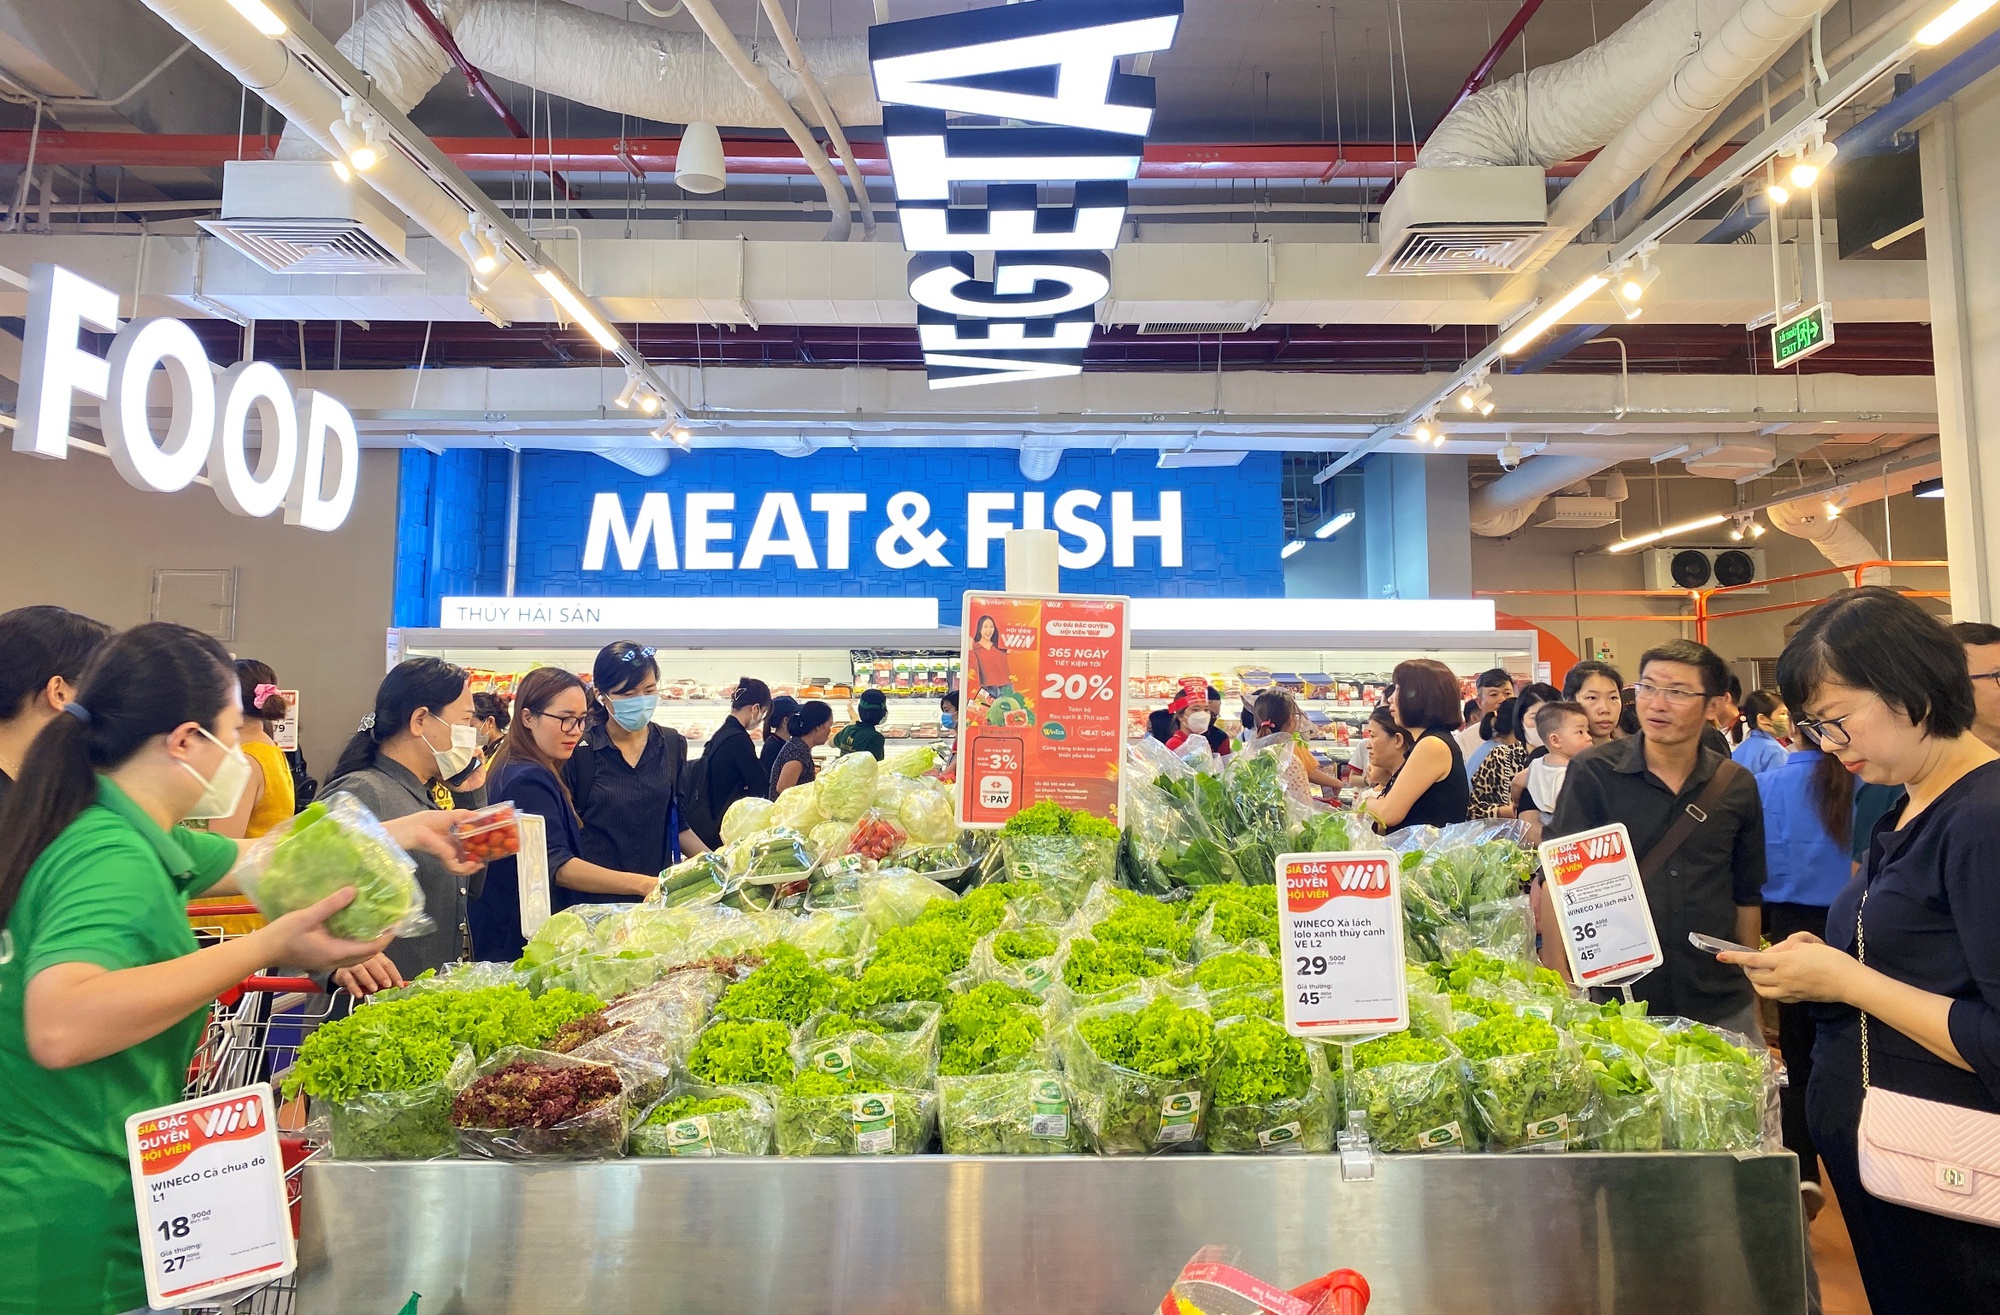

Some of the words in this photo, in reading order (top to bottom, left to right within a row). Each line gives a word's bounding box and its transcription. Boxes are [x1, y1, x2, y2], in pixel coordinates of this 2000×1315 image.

[869, 3, 1183, 390] VEGETA
[1782, 342, 1797, 357] EXIT
[14, 264, 359, 531] FOOD
[582, 492, 867, 570] MEAT
[875, 490, 954, 569] &
[1048, 648, 1071, 658] 365
[1074, 647, 1109, 658] NGÀY
[1041, 673, 1114, 700] 20%
[990, 754, 1018, 770] 3%
[982, 796, 1010, 804] T-PAY
[1560, 842, 1578, 853] ĐẶC
[1286, 864, 1302, 875] GIÁ
[1302, 864, 1327, 876] ĐẶC
[1566, 863, 1584, 874] VIÊN
[1286, 874, 1328, 888] QUYỀN
[1288, 890, 1304, 900] HỘI
[1306, 888, 1329, 899] VIÊN
[1568, 904, 1594, 916] WINECO
[1294, 919, 1335, 928] WINECO
[1352, 917, 1372, 927] lách
[1294, 929, 1312, 938] lolo
[1314, 929, 1337, 938] xanh
[1363, 928, 1386, 936] canh
[1572, 922, 1596, 942] 36
[1295, 940, 1308, 948] VE
[1310, 940, 1322, 948] L2
[1580, 950, 1594, 960] 45
[1296, 956, 1328, 976] 29
[1298, 992, 1320, 1005] 45
[138, 1120, 158, 1136] GIÁ
[158, 1114, 188, 1130] ĐẶC
[140, 1128, 190, 1150] QUYỀN
[141, 1148, 162, 1162] HỘI
[164, 1142, 192, 1158] VIÊN
[151, 1172, 200, 1192] WINECO
[222, 1161, 248, 1174] chua
[153, 1192, 165, 1202] L1
[158, 1216, 190, 1242] 18
[160, 1249, 172, 1258] Giá
[162, 1256, 186, 1274] 27
